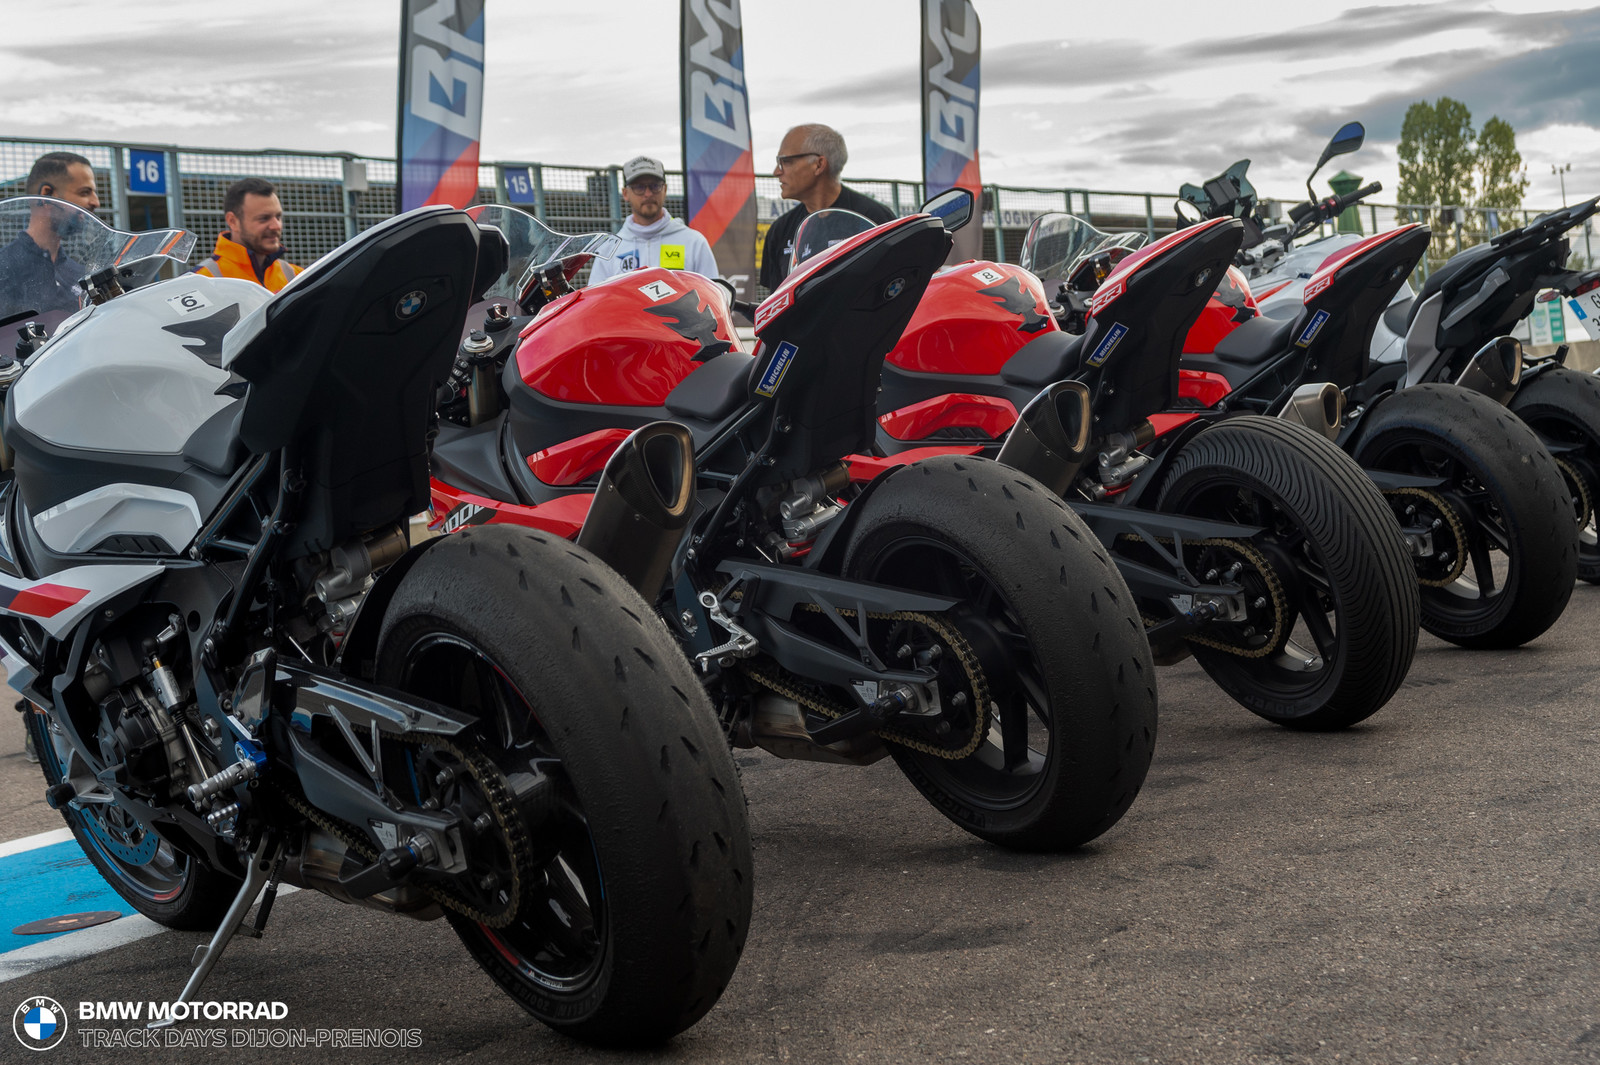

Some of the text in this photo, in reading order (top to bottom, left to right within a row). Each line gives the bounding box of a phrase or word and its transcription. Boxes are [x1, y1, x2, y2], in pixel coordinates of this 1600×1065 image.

[136, 159, 160, 183] 16
[511, 176, 528, 194] 15
[649, 284, 661, 295] 7
[181, 295, 198, 307] 6
[1100, 328, 1122, 357] MICHELIN
[768, 348, 790, 385] MICHELIN
